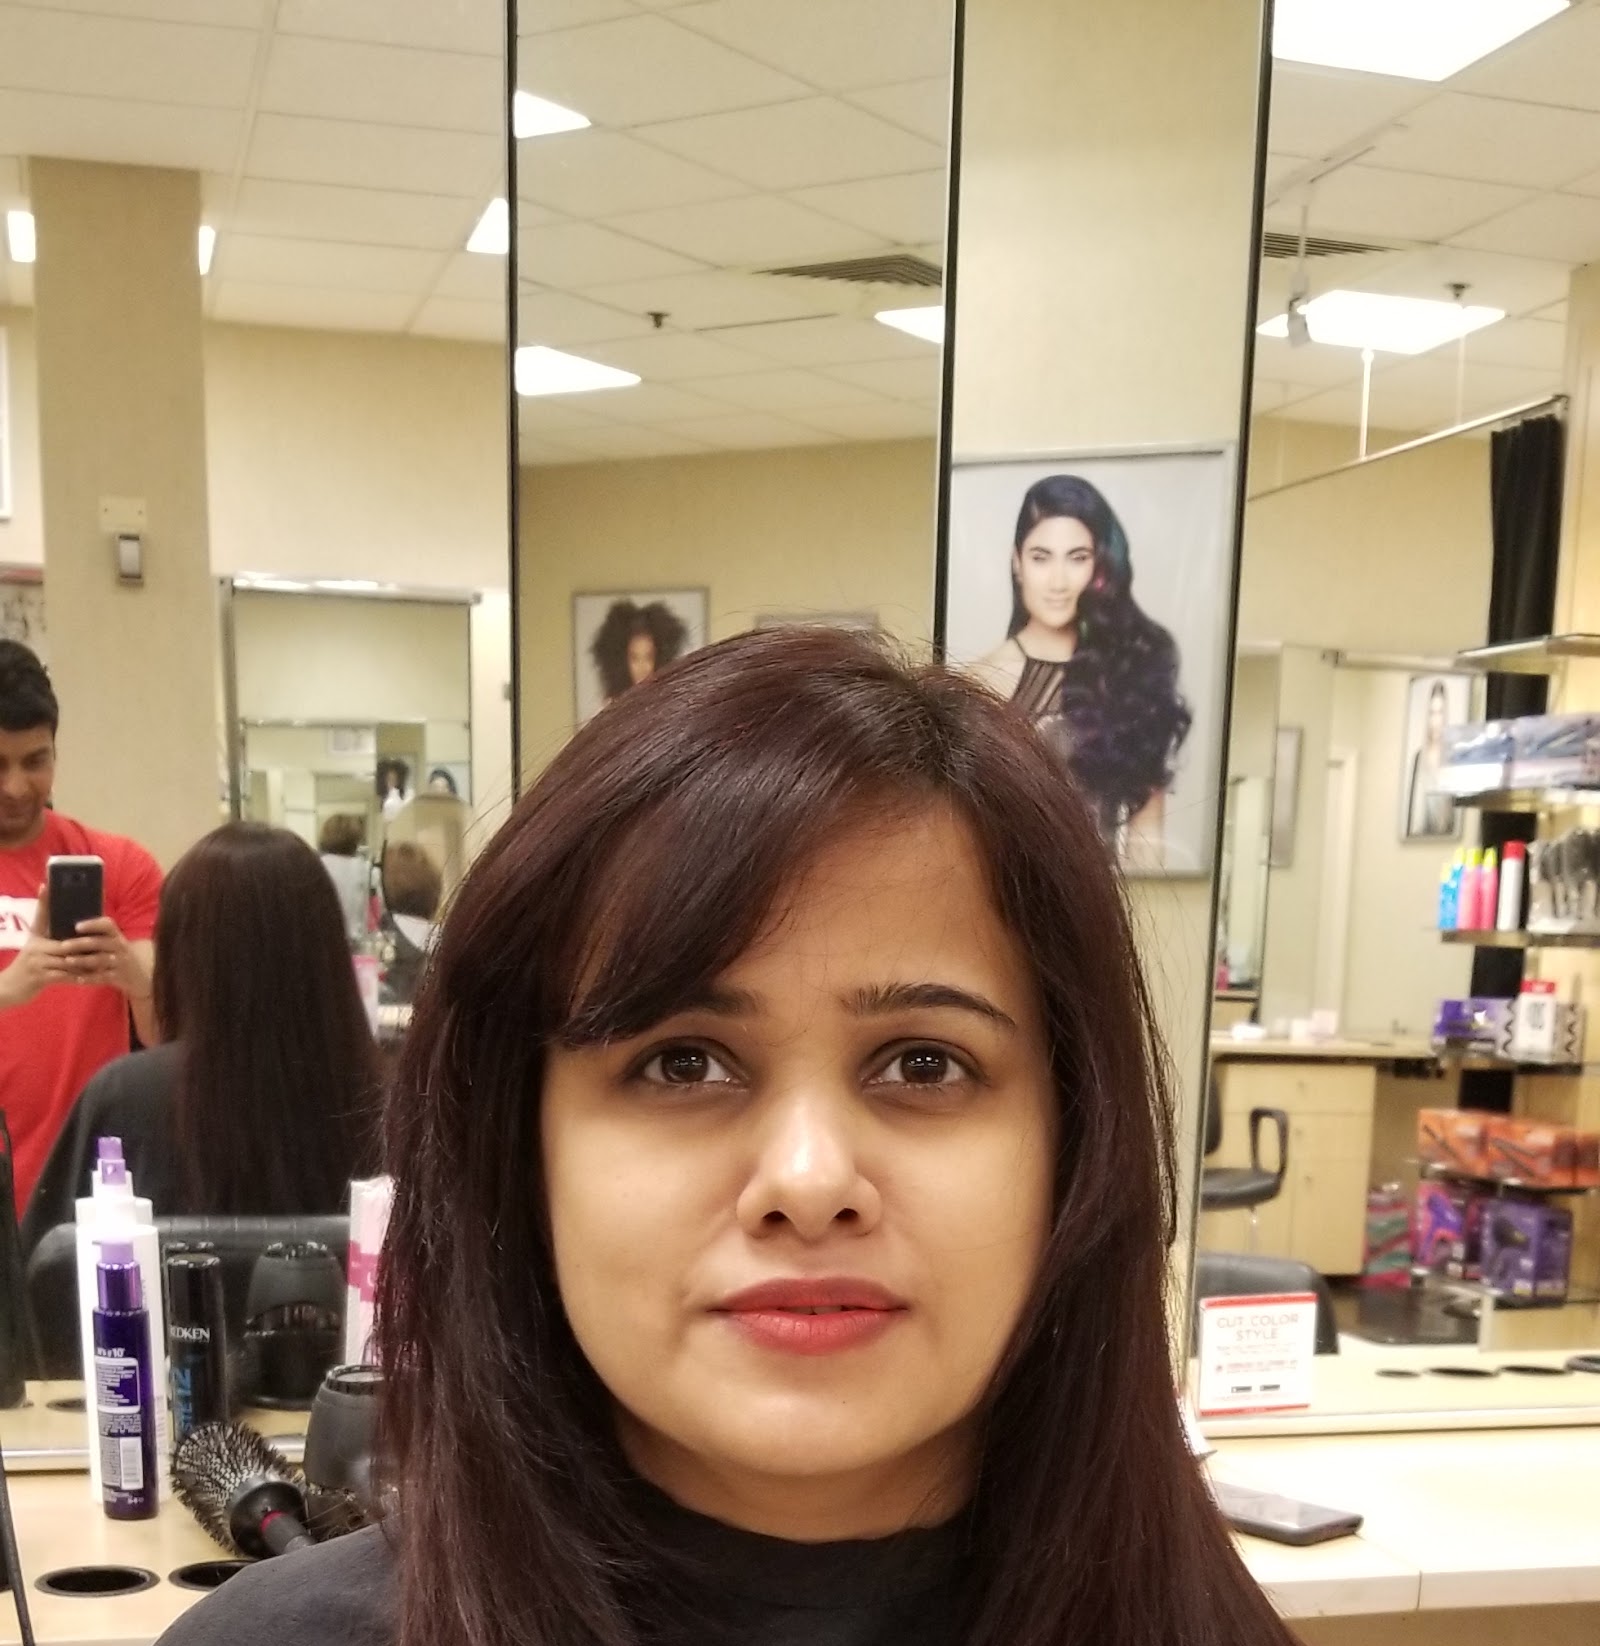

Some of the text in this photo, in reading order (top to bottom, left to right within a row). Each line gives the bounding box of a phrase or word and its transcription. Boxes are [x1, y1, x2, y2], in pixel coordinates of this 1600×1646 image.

[1216, 1313, 1299, 1328] CUT COLOR
[169, 1325, 210, 1342] DKEN
[1235, 1328, 1278, 1341] STYLE
